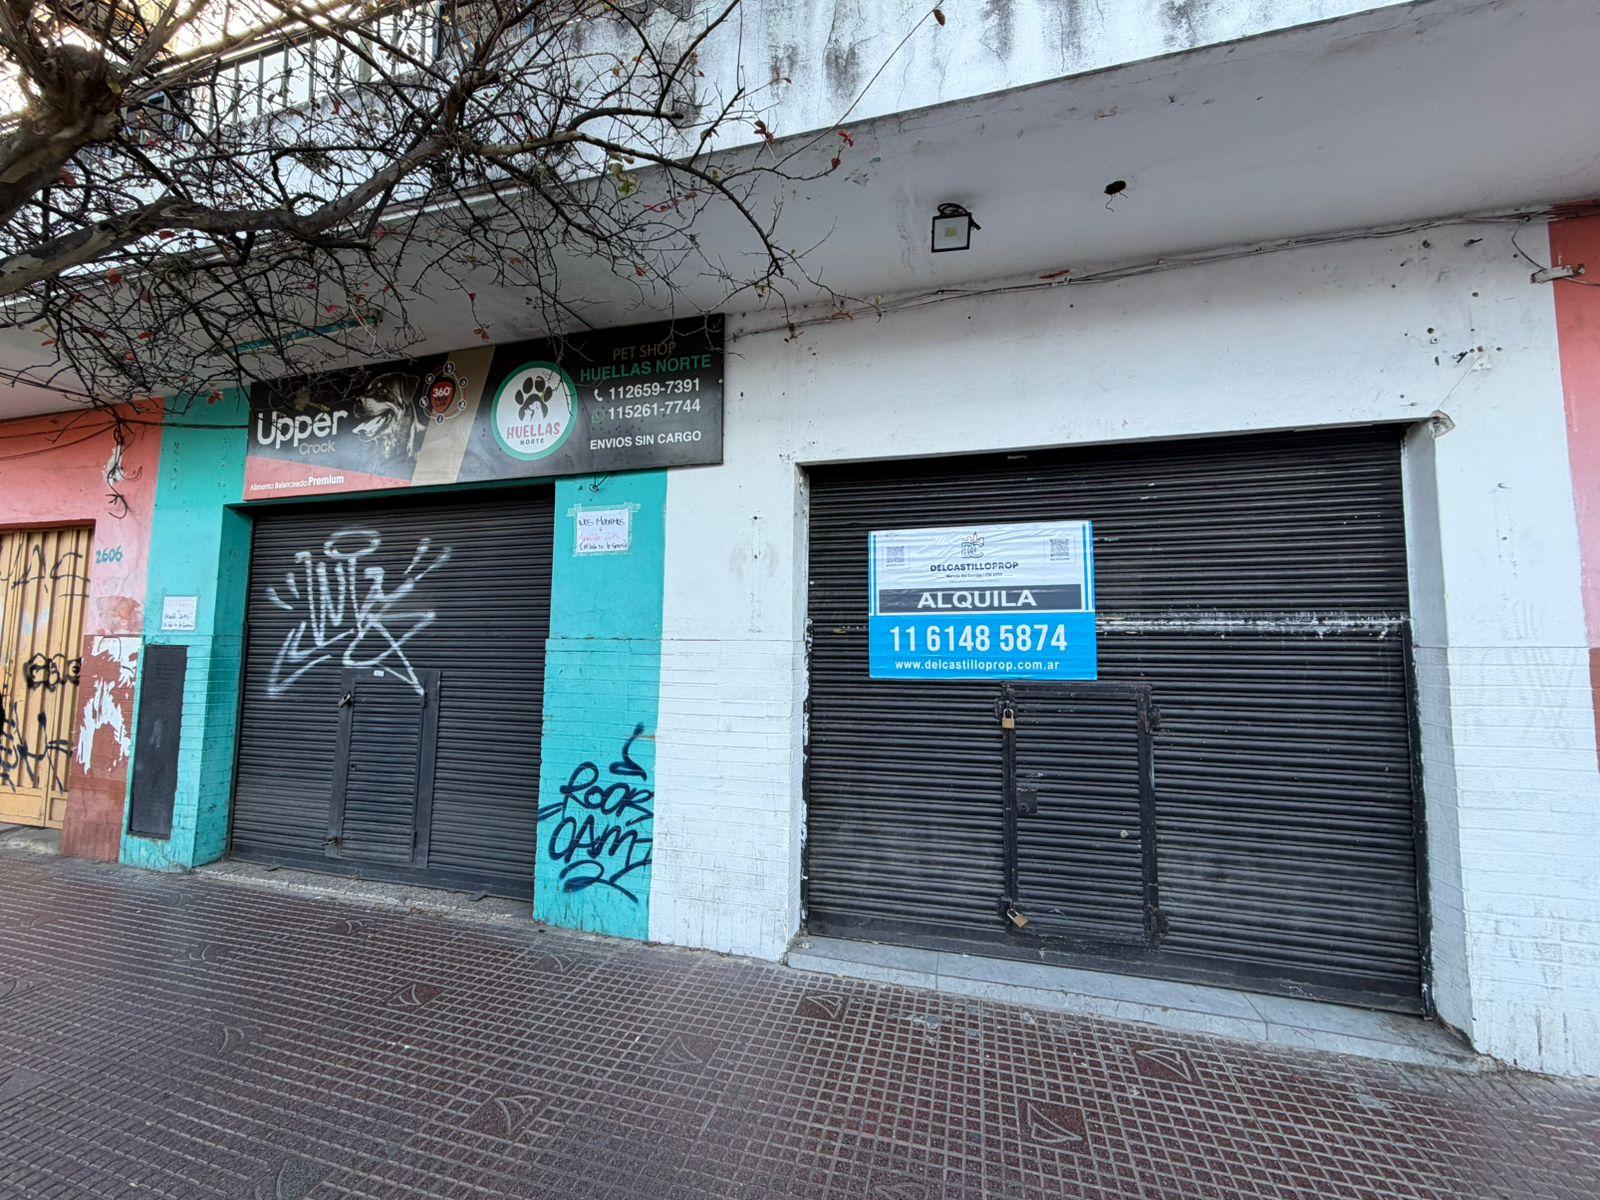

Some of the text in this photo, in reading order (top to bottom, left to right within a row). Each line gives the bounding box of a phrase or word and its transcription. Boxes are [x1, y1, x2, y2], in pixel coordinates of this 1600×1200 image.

[613, 341, 677, 360] PET SHOP
[580, 354, 712, 382] HUELLAS NORTE
[609, 378, 700, 400] 112659-7391
[607, 399, 701, 420] 115261-7744
[257, 410, 348, 449] Upper
[506, 422, 561, 439] HUELLAS
[299, 441, 336, 455] Crock
[519, 438, 545, 446] NORTE
[590, 431, 702, 450] ENVIOS SIN CARGO
[308, 474, 345, 487] Premium
[95, 545, 123, 565] 2606
[930, 561, 1019, 573] DELCASTILLOPROP
[917, 589, 1038, 609] ALQUILA
[889, 624, 1068, 652] 11 6148 5874
[894, 659, 1060, 673] www.delcastilloprop.com.ar
